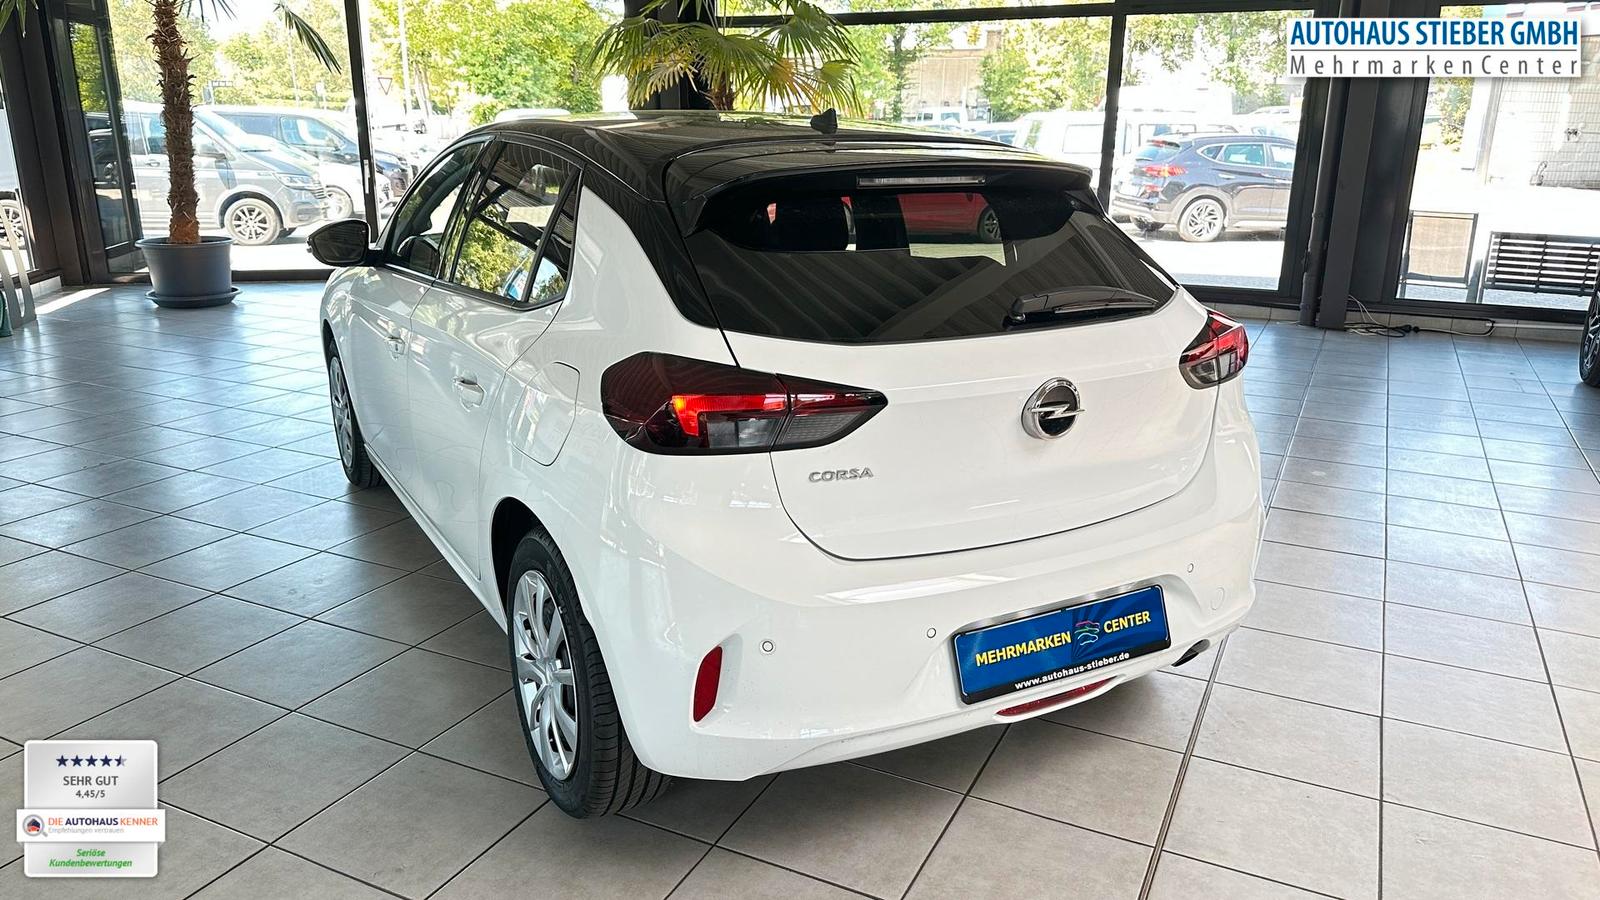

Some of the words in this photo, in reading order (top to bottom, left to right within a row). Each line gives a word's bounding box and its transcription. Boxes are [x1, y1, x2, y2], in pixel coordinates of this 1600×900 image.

[808, 467, 874, 484] CORSA
[975, 631, 1072, 667] MEHRMARKEN
[1103, 610, 1152, 634] CENTER
[1014, 652, 1130, 690] www.autohaus-stieber.de
